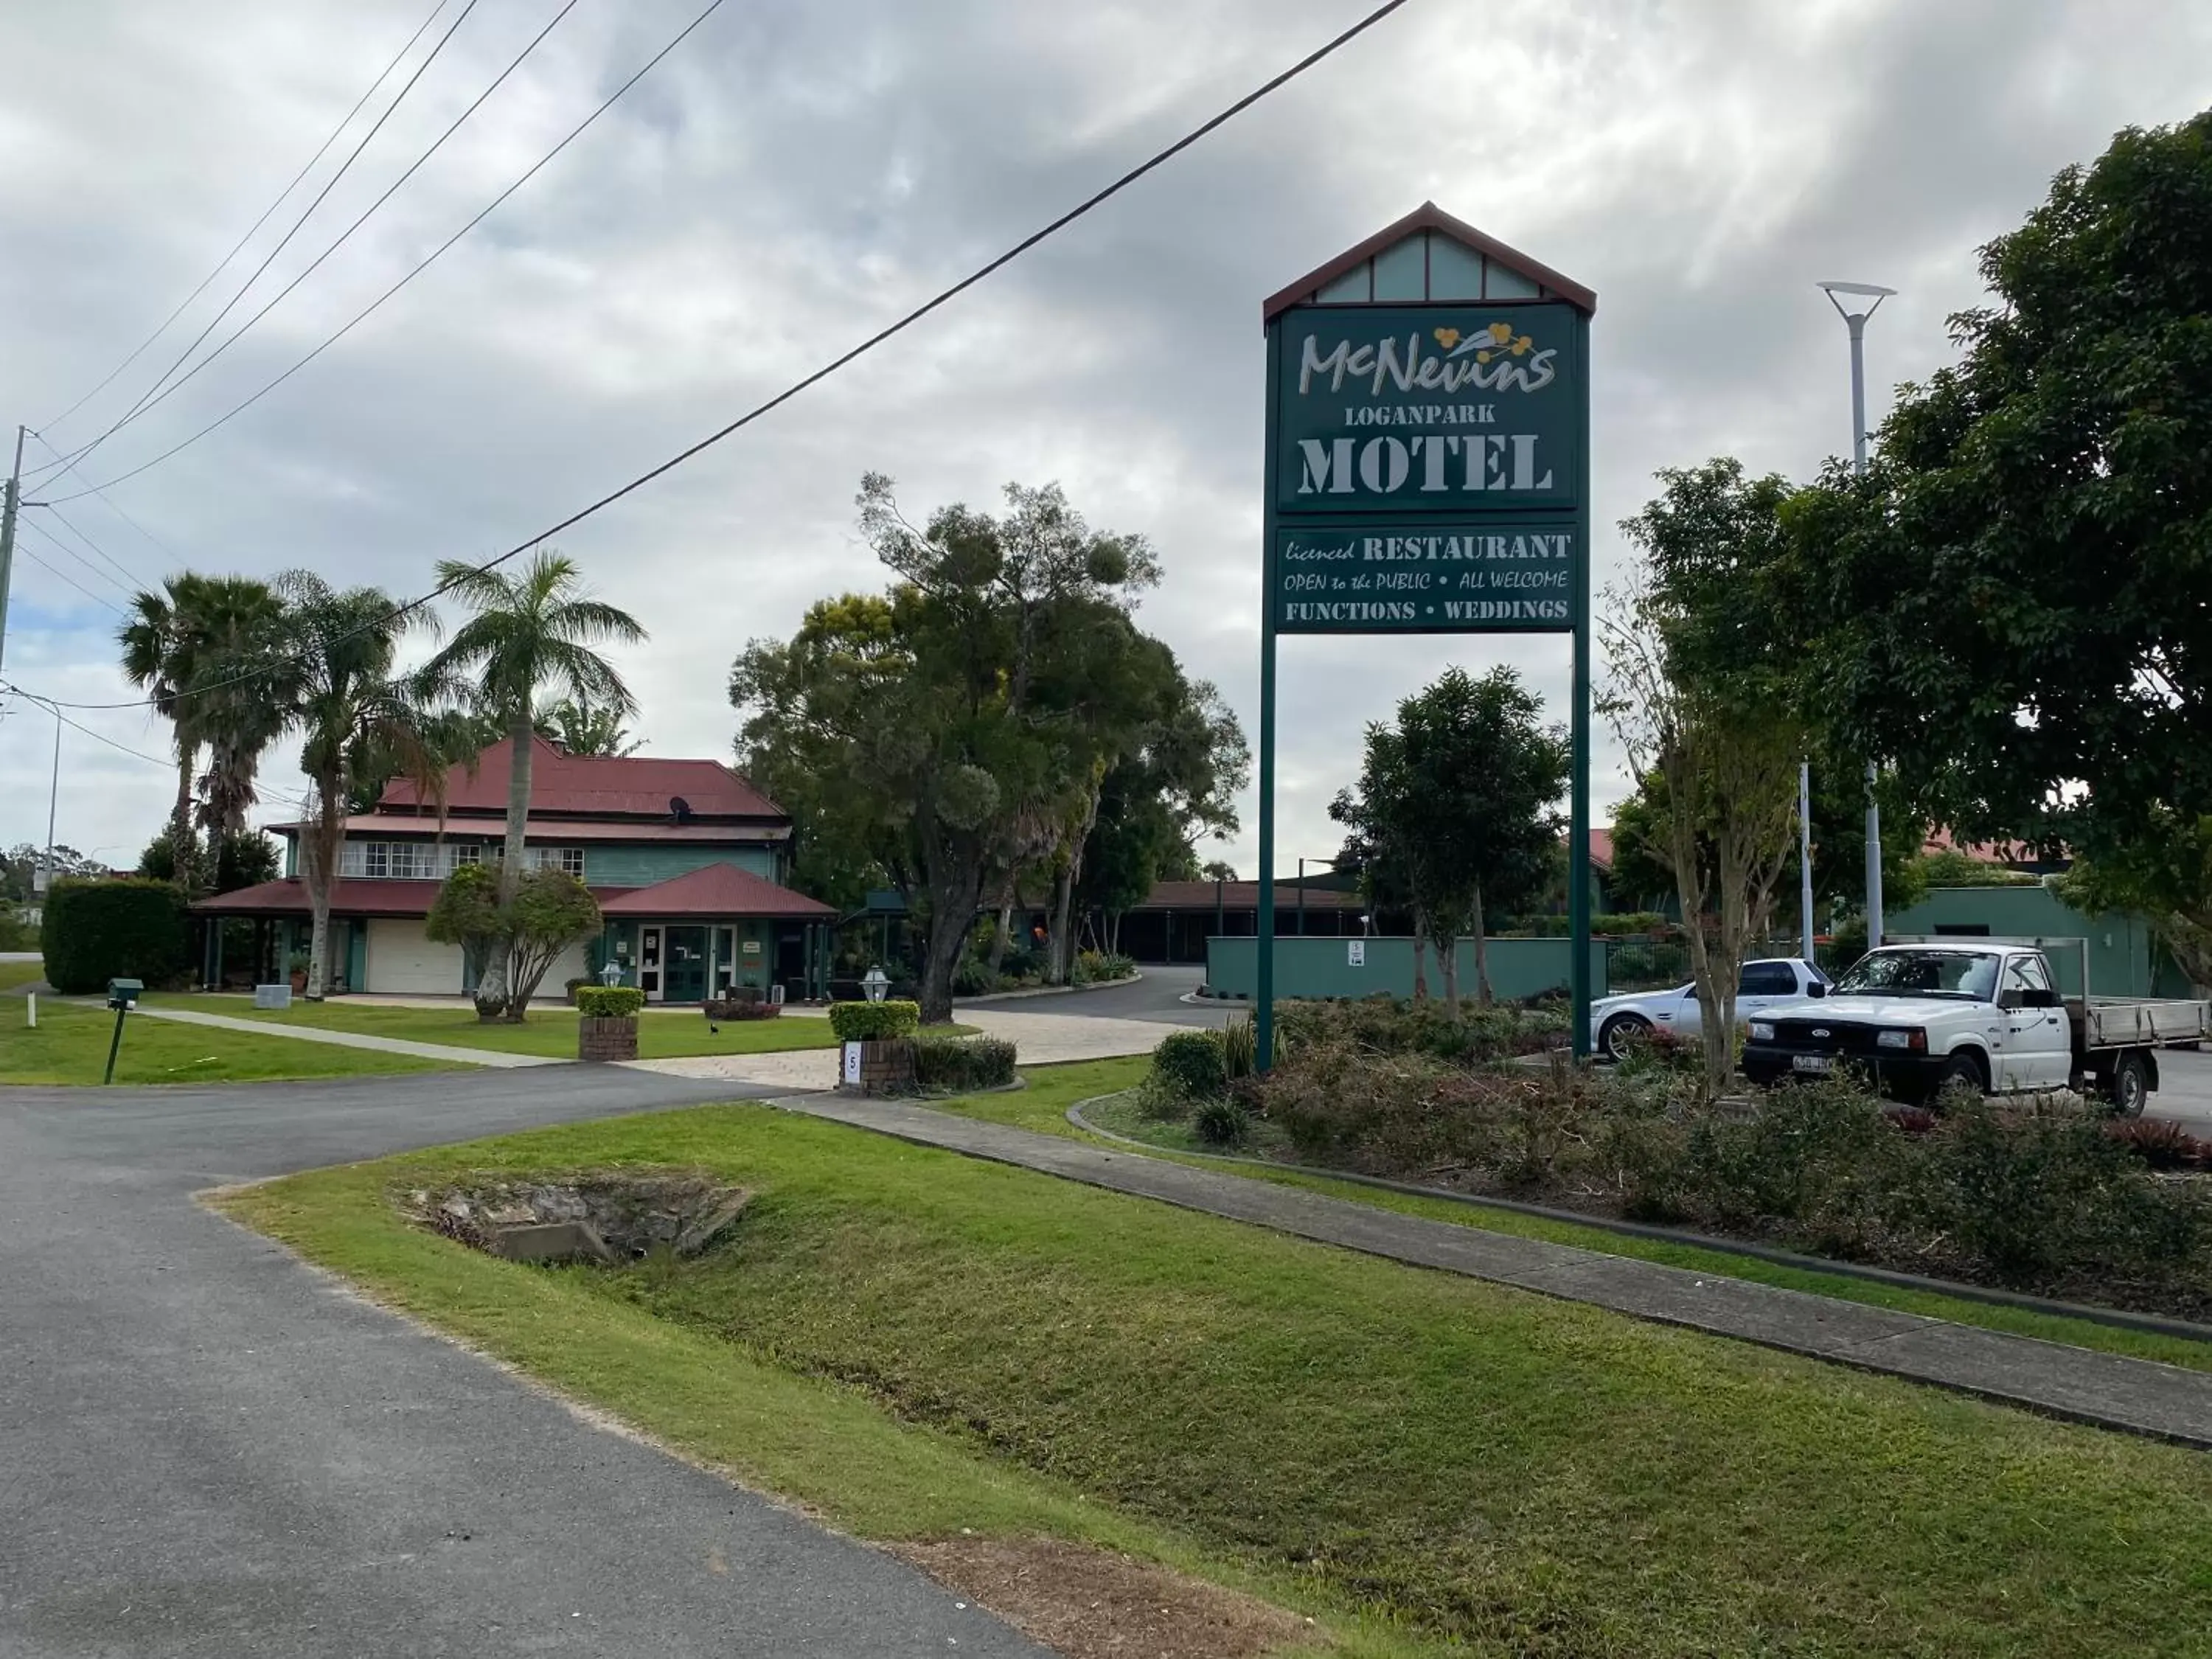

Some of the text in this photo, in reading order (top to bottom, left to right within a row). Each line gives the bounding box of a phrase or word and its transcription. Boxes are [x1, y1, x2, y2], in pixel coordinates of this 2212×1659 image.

[1345, 403, 1496, 426] LOGANPARK
[1298, 434, 1553, 494] MOTEL
[1363, 535, 1571, 560] RESTAURANT
[1284, 570, 1569, 591] OPEN to the PUBLIC ALL WELCOME
[1285, 600, 1568, 621] FUNCTIONS WEDDINGS
